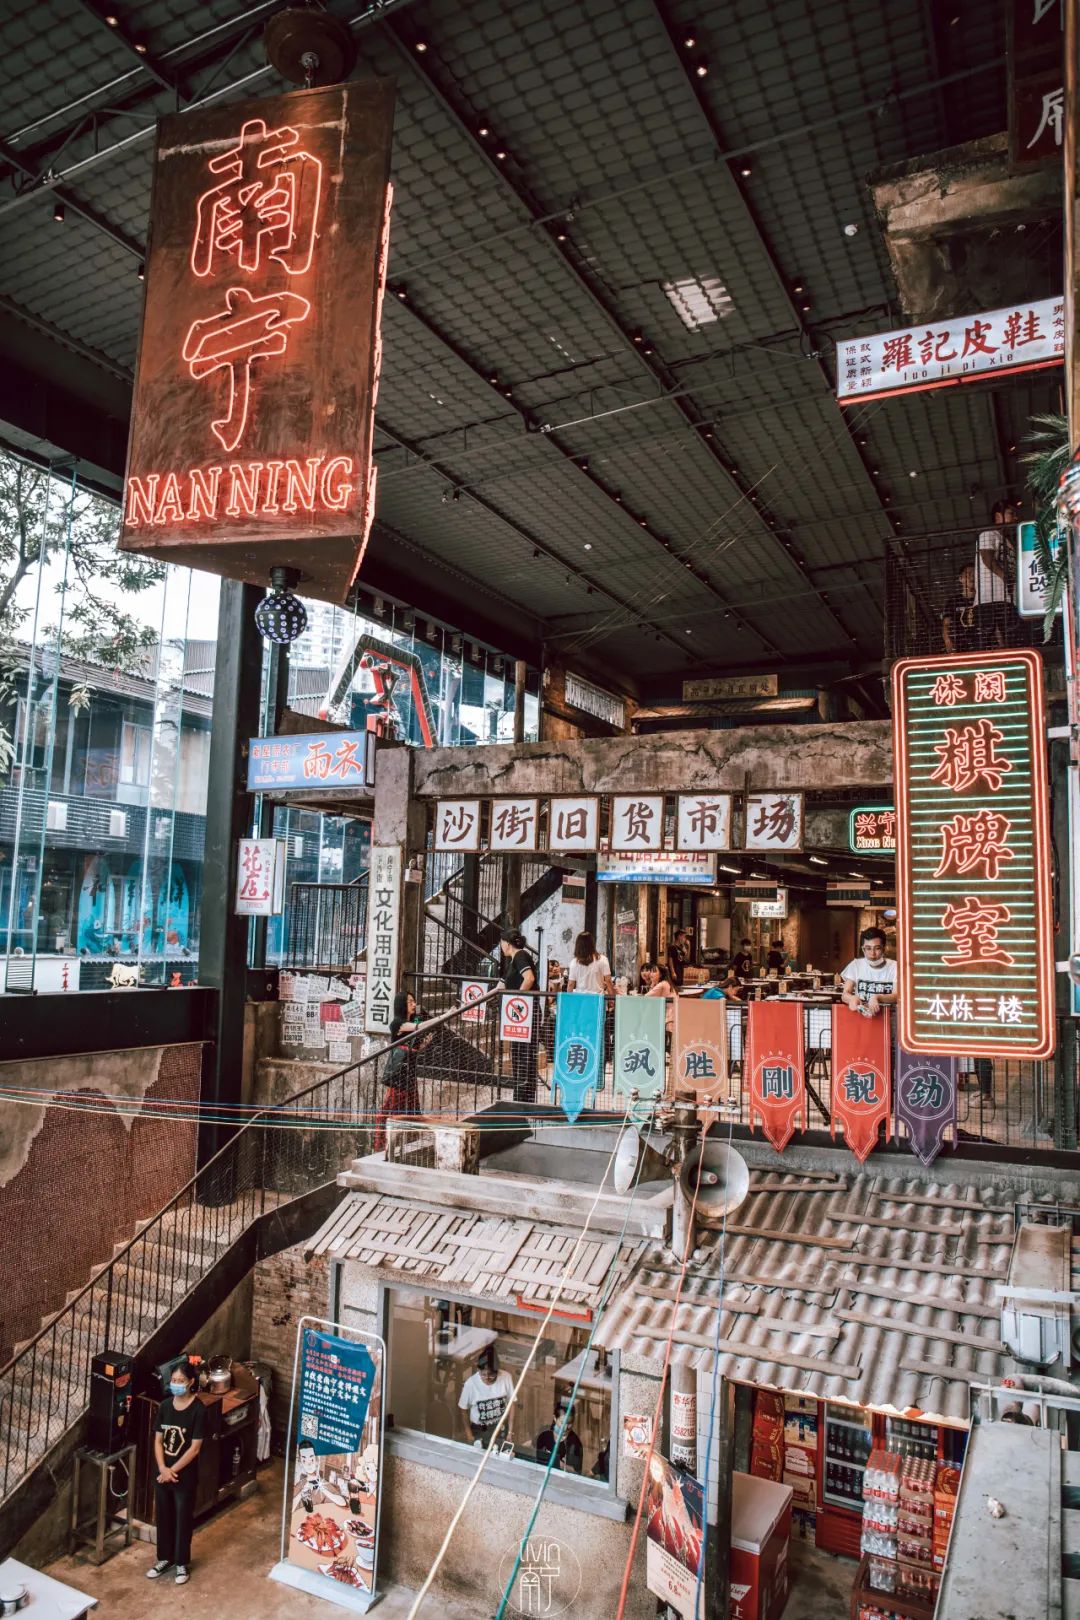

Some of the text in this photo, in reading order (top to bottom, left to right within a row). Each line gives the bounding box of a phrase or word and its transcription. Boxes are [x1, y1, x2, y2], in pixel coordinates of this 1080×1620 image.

[182, 118, 322, 452] 南宁
[880, 309, 1047, 374] 羅記皮鞋
[903, 352, 1014, 382] luo ji pi xie
[125, 455, 354, 527] NANNING
[302, 740, 363, 779] 雨衣
[441, 799, 796, 845] 沙街旧货市场
[855, 811, 896, 836] 兴宁
[930, 718, 1014, 967] 棋牌室
[242, 845, 262, 897] 花店
[370, 887, 395, 1026] 文化用品公司
[926, 993, 1023, 1024] 本栋三楼
[566, 1043, 589, 1076] 勇
[623, 1047, 656, 1078] 飒
[684, 1050, 718, 1080] 胜
[761, 1066, 795, 1099] 剛
[842, 1068, 880, 1105] 靓
[906, 1073, 944, 1109] 劲
